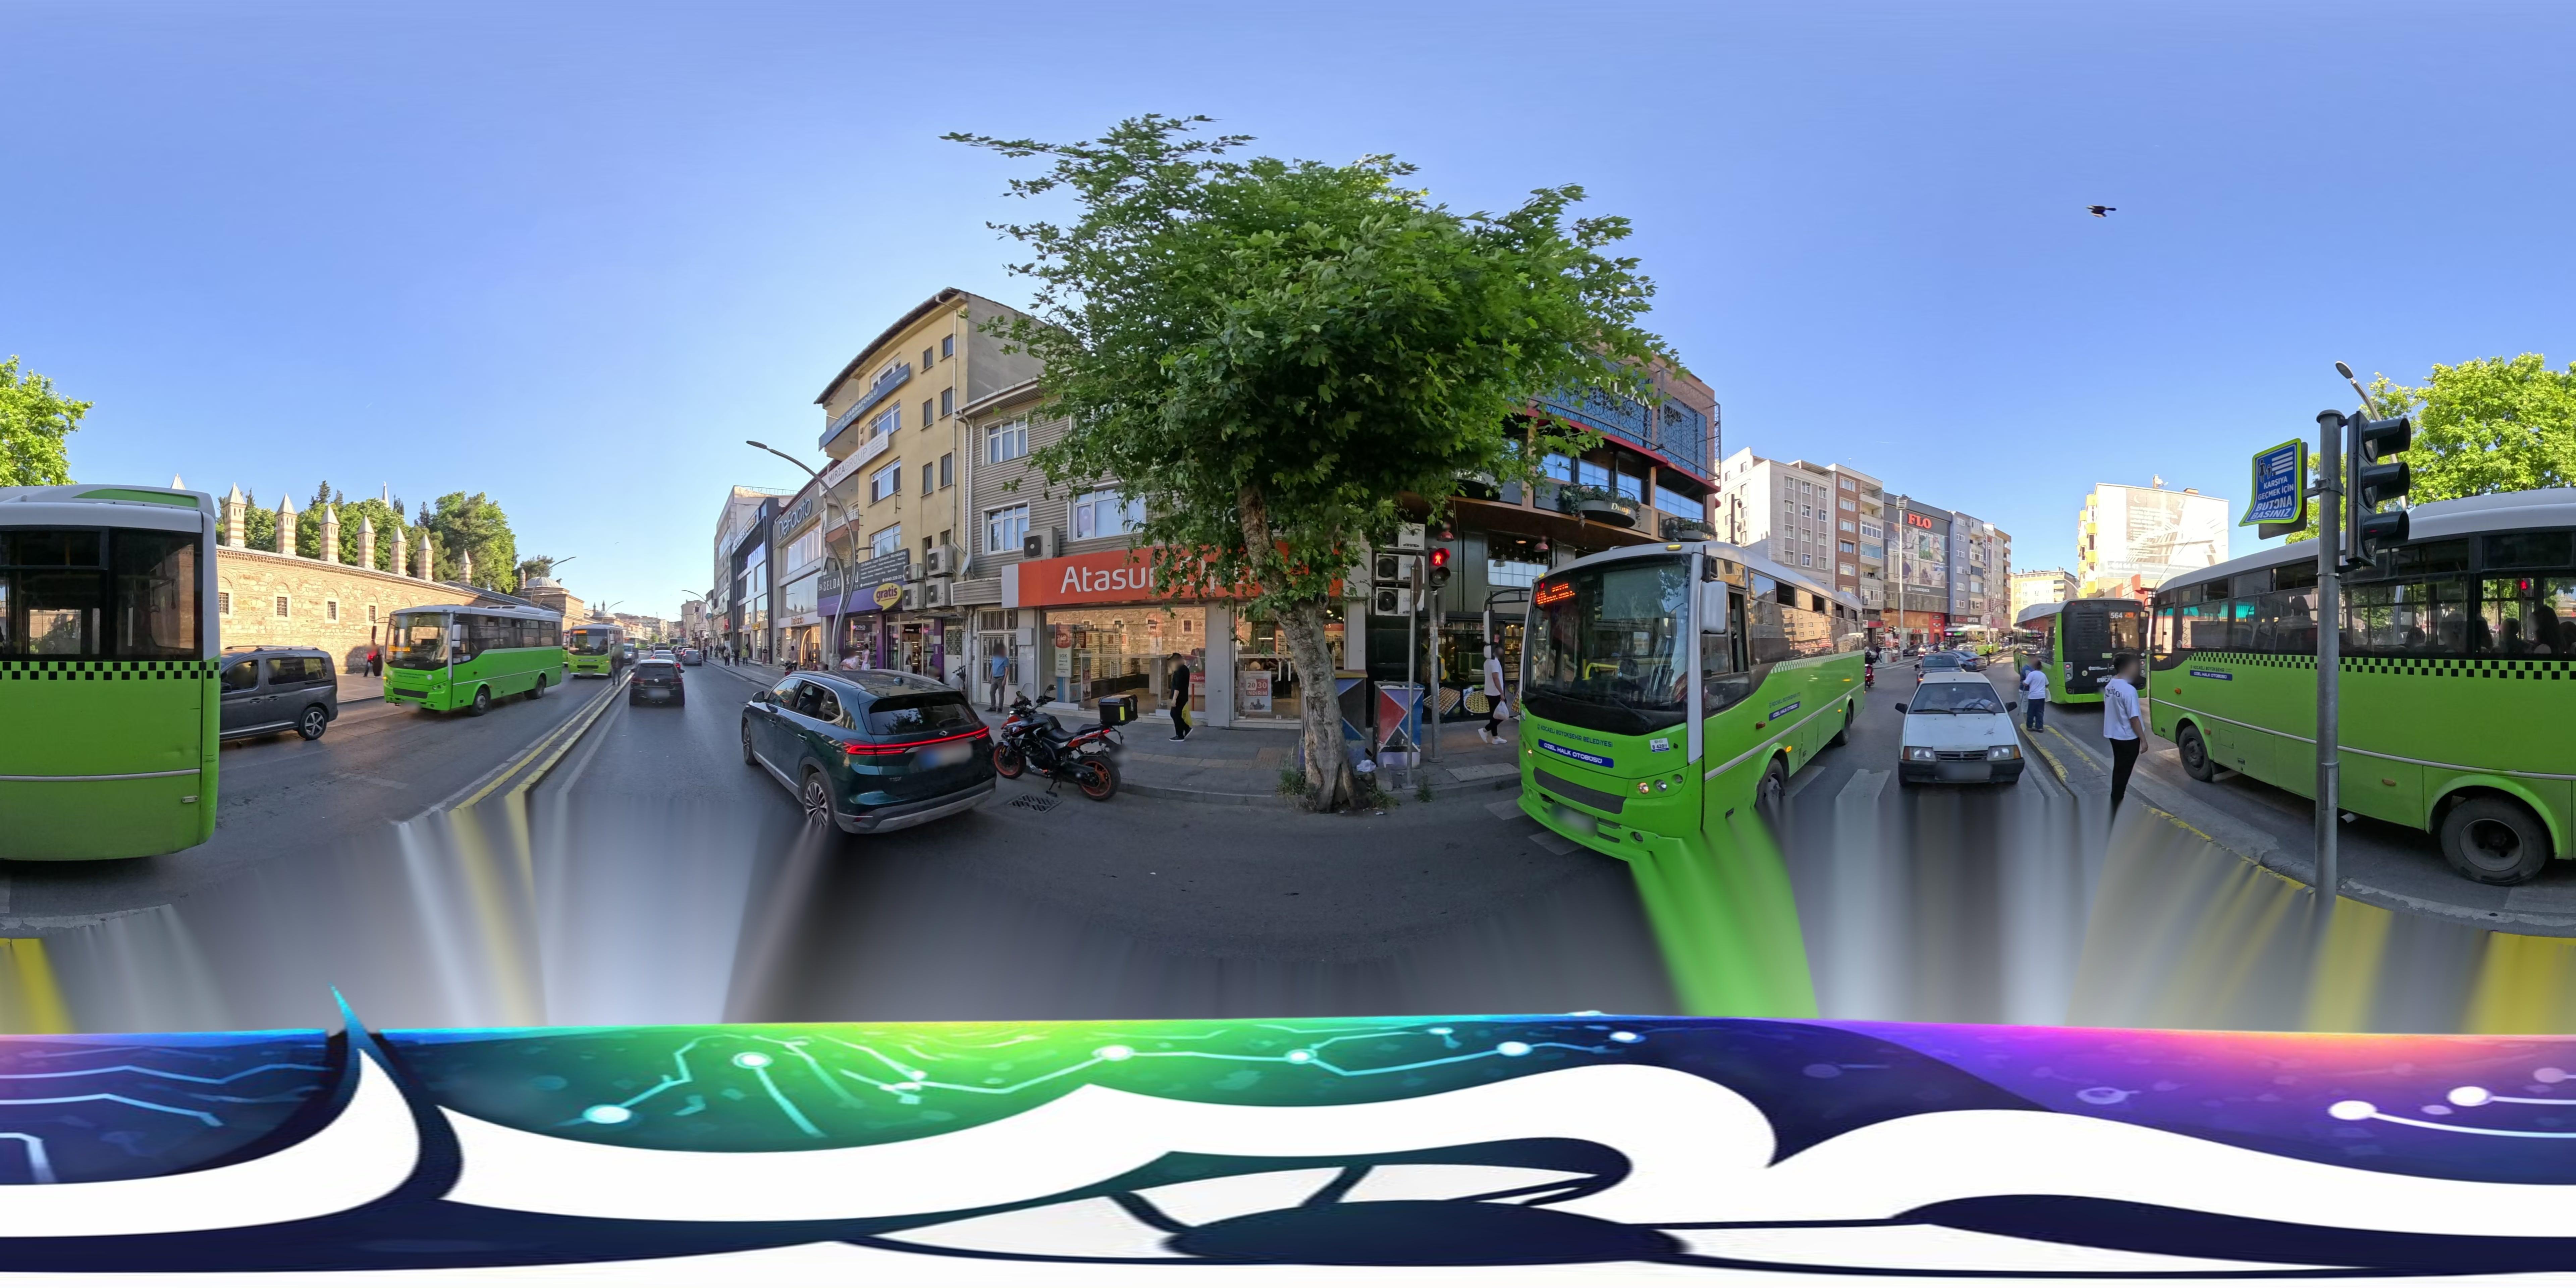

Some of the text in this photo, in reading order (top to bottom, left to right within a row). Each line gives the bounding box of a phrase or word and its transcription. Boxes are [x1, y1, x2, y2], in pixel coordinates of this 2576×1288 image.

[2263, 476, 2288, 489] KARŞIYA
[2258, 484, 2294, 500] GEÇMEK İÇİN
[2255, 495, 2293, 512] BUTONA
[779, 498, 812, 540] DeFacto
[1908, 513, 1932, 529] FLO
[2250, 508, 2291, 520] BASINIZ
[823, 578, 840, 591] SELDA
[876, 585, 897, 602] gratis
[791, 616, 803, 625] DeFacto
[1541, 725, 1555, 733] KOCAELİ
[1583, 736, 1613, 747] BELEDİYESİ
[1557, 747, 1571, 756] HALK
[1572, 752, 1602, 763] OTOBÜSÜ
